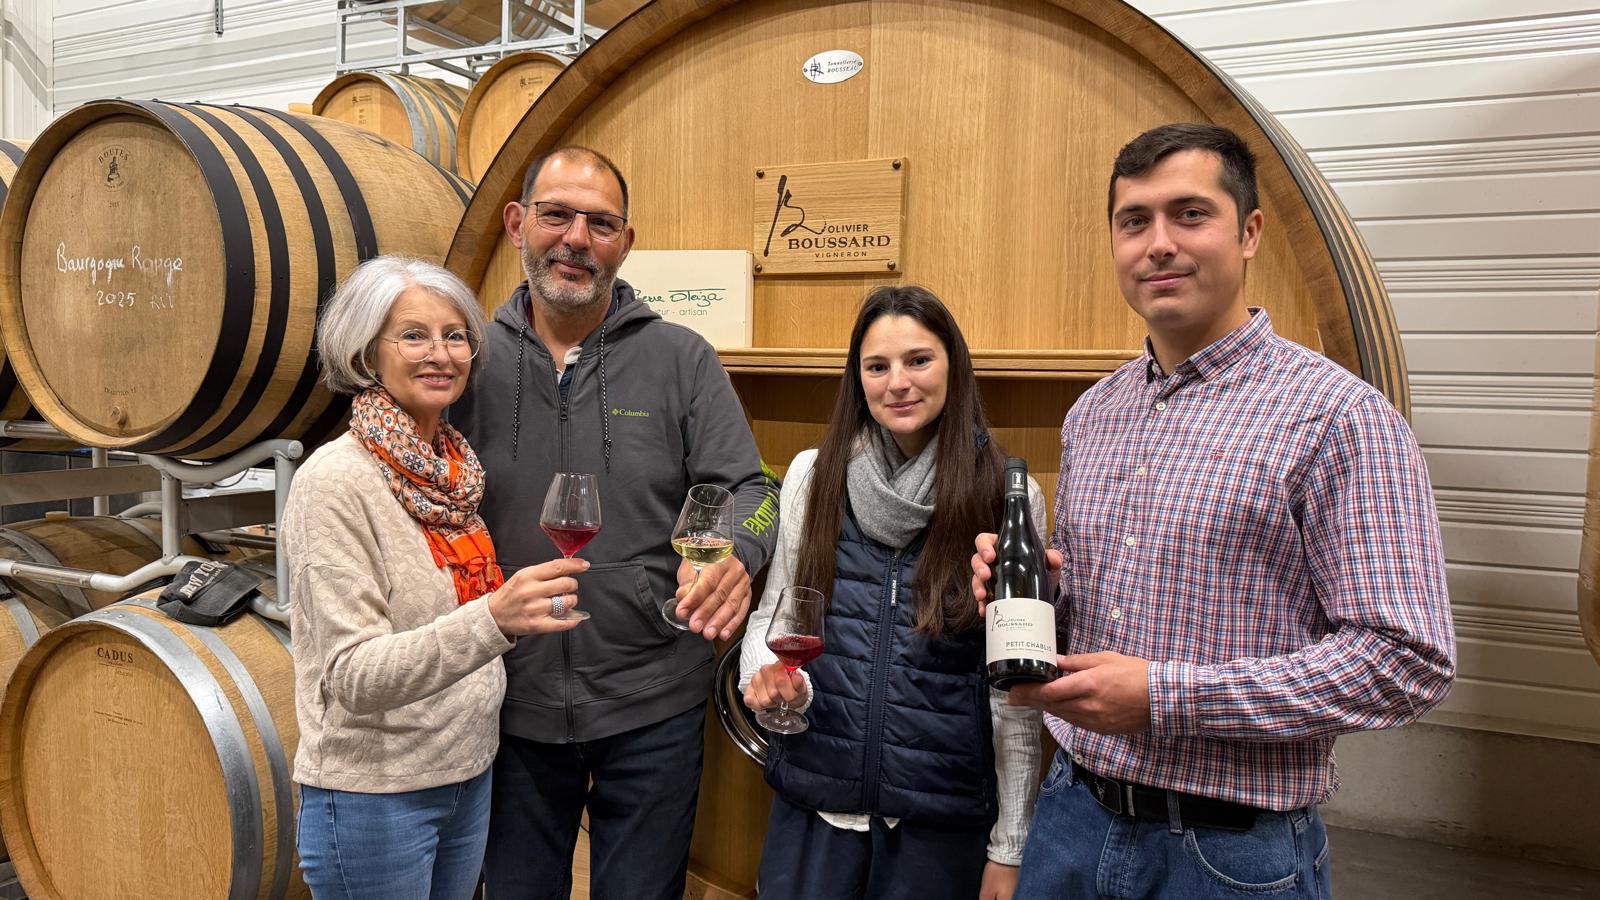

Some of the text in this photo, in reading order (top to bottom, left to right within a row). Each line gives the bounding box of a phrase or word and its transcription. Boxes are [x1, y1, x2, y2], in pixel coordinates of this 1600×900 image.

[827, 224, 869, 234] OLIVIER
[788, 235, 891, 250] BOUSSARD
[815, 251, 868, 259] VIGNERON
[96, 290, 137, 308] 2025
[679, 308, 708, 317] artisan
[619, 408, 650, 418] Columbia
[1026, 641, 1052, 653] CHABLIS
[97, 647, 134, 664] CADUS
